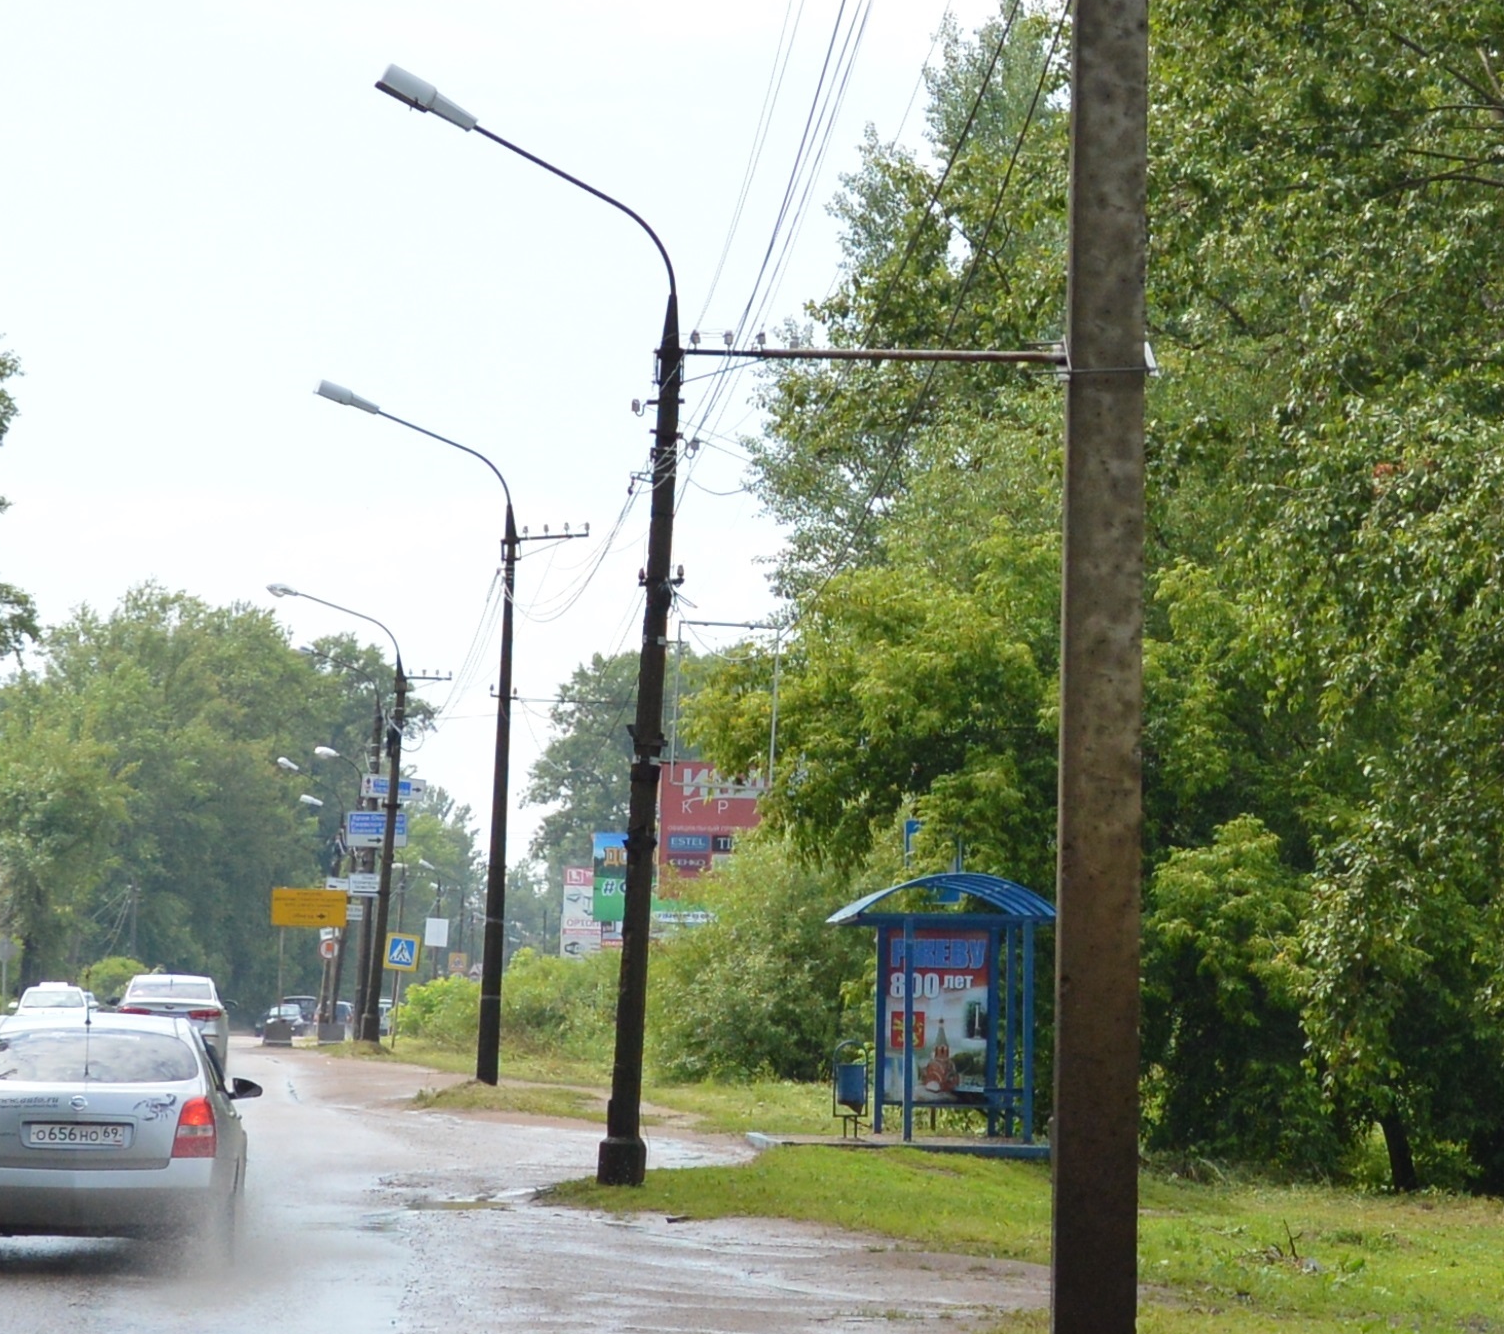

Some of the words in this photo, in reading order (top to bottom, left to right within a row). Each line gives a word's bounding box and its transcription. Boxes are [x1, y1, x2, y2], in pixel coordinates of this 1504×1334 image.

[670, 837, 705, 846] ESTEL
[891, 938, 987, 969] РЖЕВУ
[890, 972, 940, 999] 800
[942, 975, 974, 990] лет
